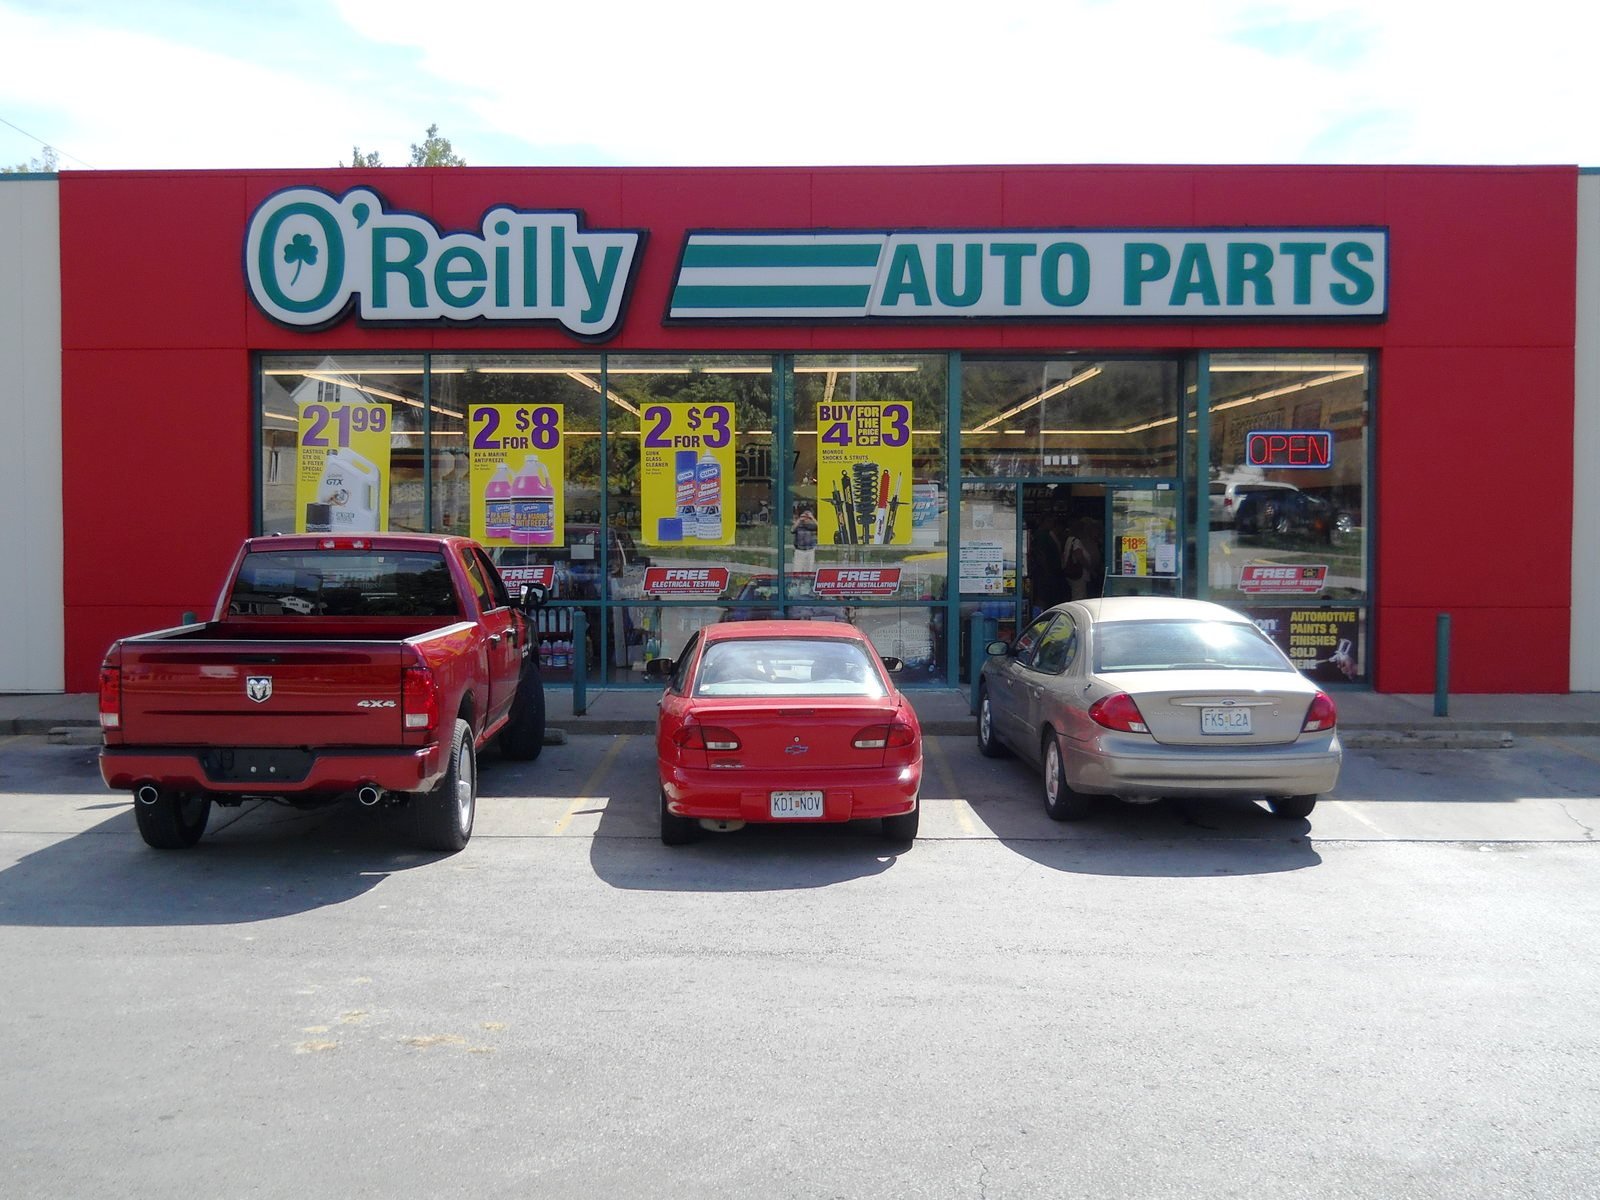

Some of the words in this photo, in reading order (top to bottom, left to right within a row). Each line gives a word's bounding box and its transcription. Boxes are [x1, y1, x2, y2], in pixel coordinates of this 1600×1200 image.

[258, 202, 624, 324] O'Reilly
[880, 242, 1091, 308] AUTO
[1123, 241, 1376, 308] PARTS
[819, 405, 855, 421] BUY
[857, 406, 879, 418] FOR
[472, 407, 501, 450] 2
[503, 436, 529, 450] FOR
[644, 405, 672, 448] 2
[674, 435, 700, 448] FOR
[858, 418, 879, 428] THE
[881, 404, 910, 447] 3
[822, 422, 853, 447] 4
[858, 428, 879, 436] PRICE
[858, 436, 879, 445] OF
[1249, 435, 1329, 465] OPEN
[501, 568, 545, 580] FREE
[665, 569, 710, 580] FREE
[837, 570, 881, 582] FREE
[1252, 568, 1297, 579] FREE
[692, 580, 720, 588] TESTING
[1290, 611, 1356, 622] AUTOMOTIVE
[1290, 623, 1327, 634] PAINTS
[1328, 623, 1338, 634] &
[1290, 635, 1337, 646] FINISHES
[1289, 647, 1317, 658] SOLD
[1204, 713, 1224, 727] FK5
[1229, 713, 1249, 727] L2A
[800, 796, 820, 811] NOV
